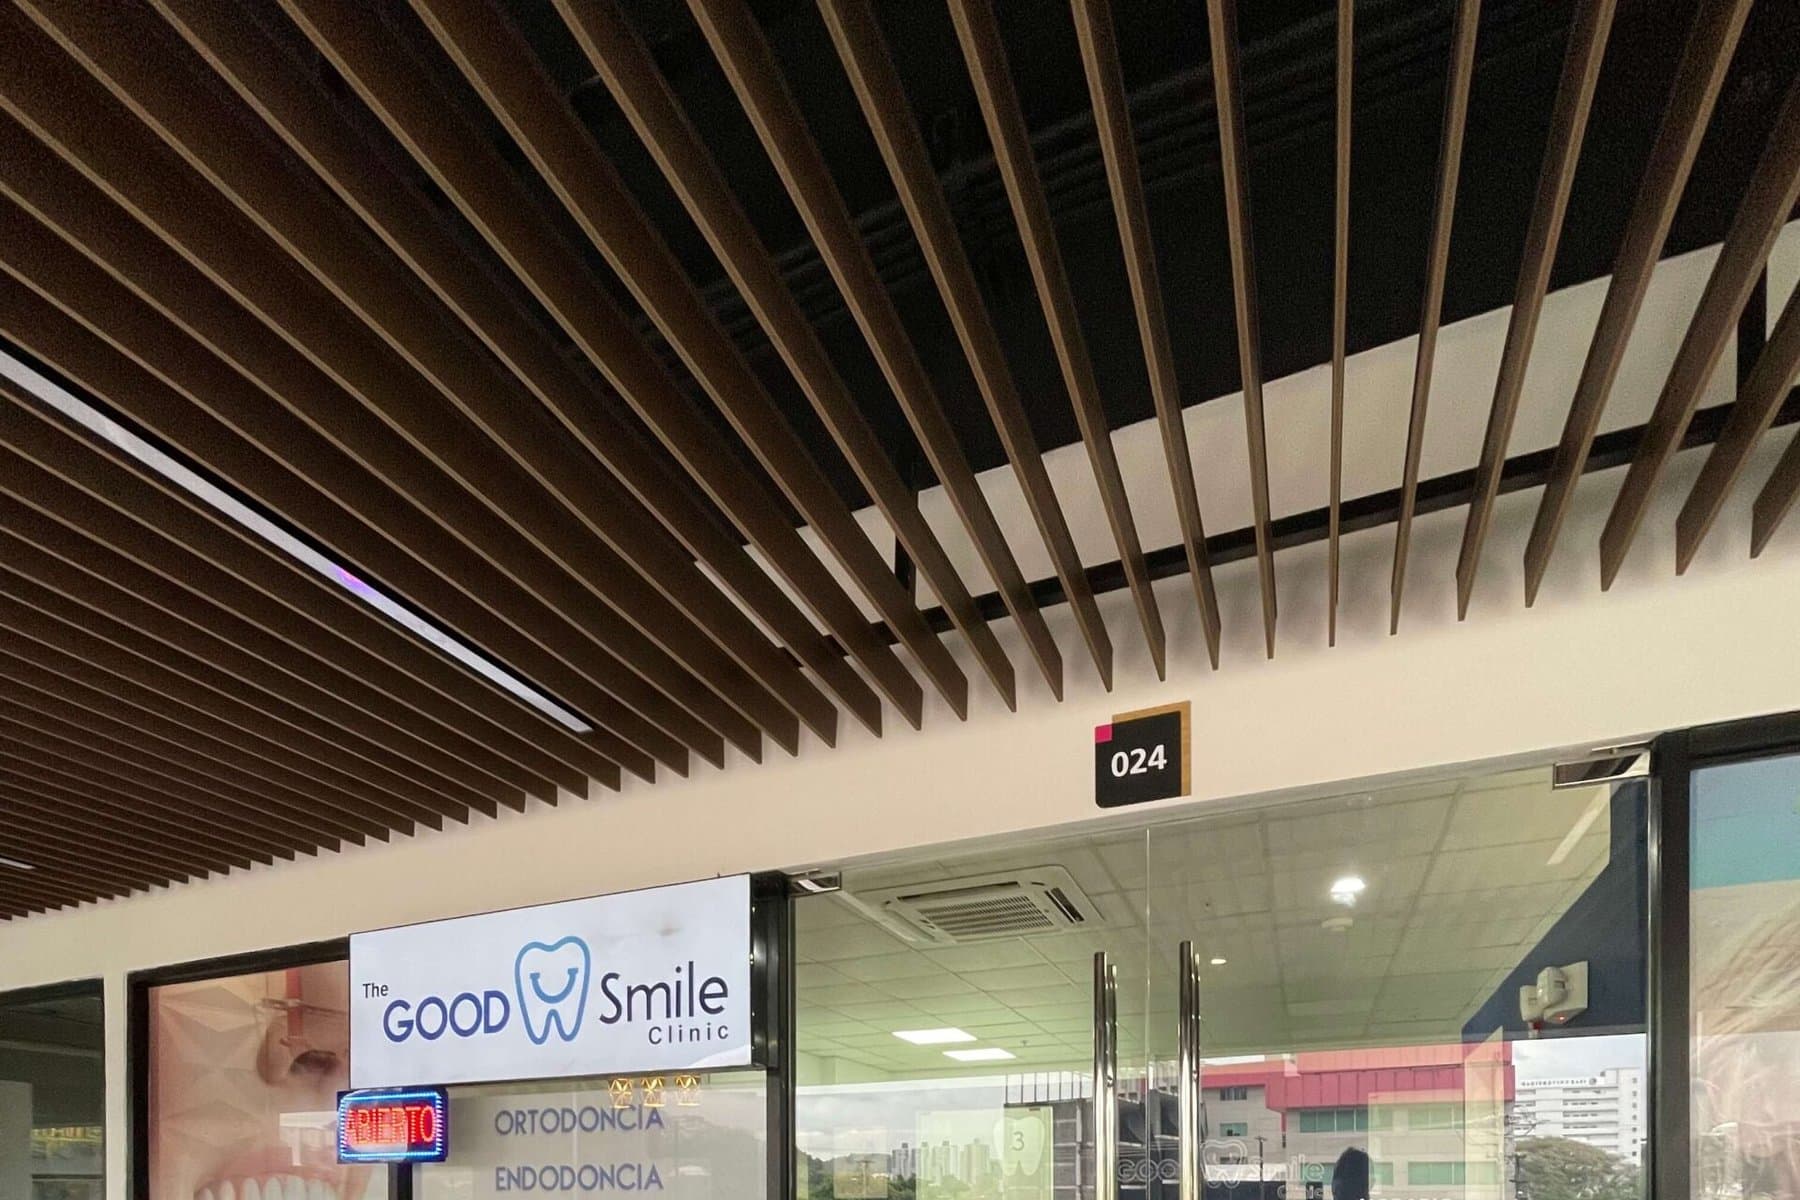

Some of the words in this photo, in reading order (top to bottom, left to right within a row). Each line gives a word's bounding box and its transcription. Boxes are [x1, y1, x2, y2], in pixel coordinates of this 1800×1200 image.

[1110, 744, 1168, 777] 024
[362, 982, 389, 999] The
[382, 989, 511, 1043] GOOD
[599, 960, 729, 1025] Smile
[648, 1020, 729, 1045] Clinic
[346, 1104, 436, 1145] ABIERTO
[494, 1105, 665, 1136] ORTODONCIA
[1012, 1131, 1025, 1151] 3
[495, 1164, 664, 1192] ENDODONCIA
